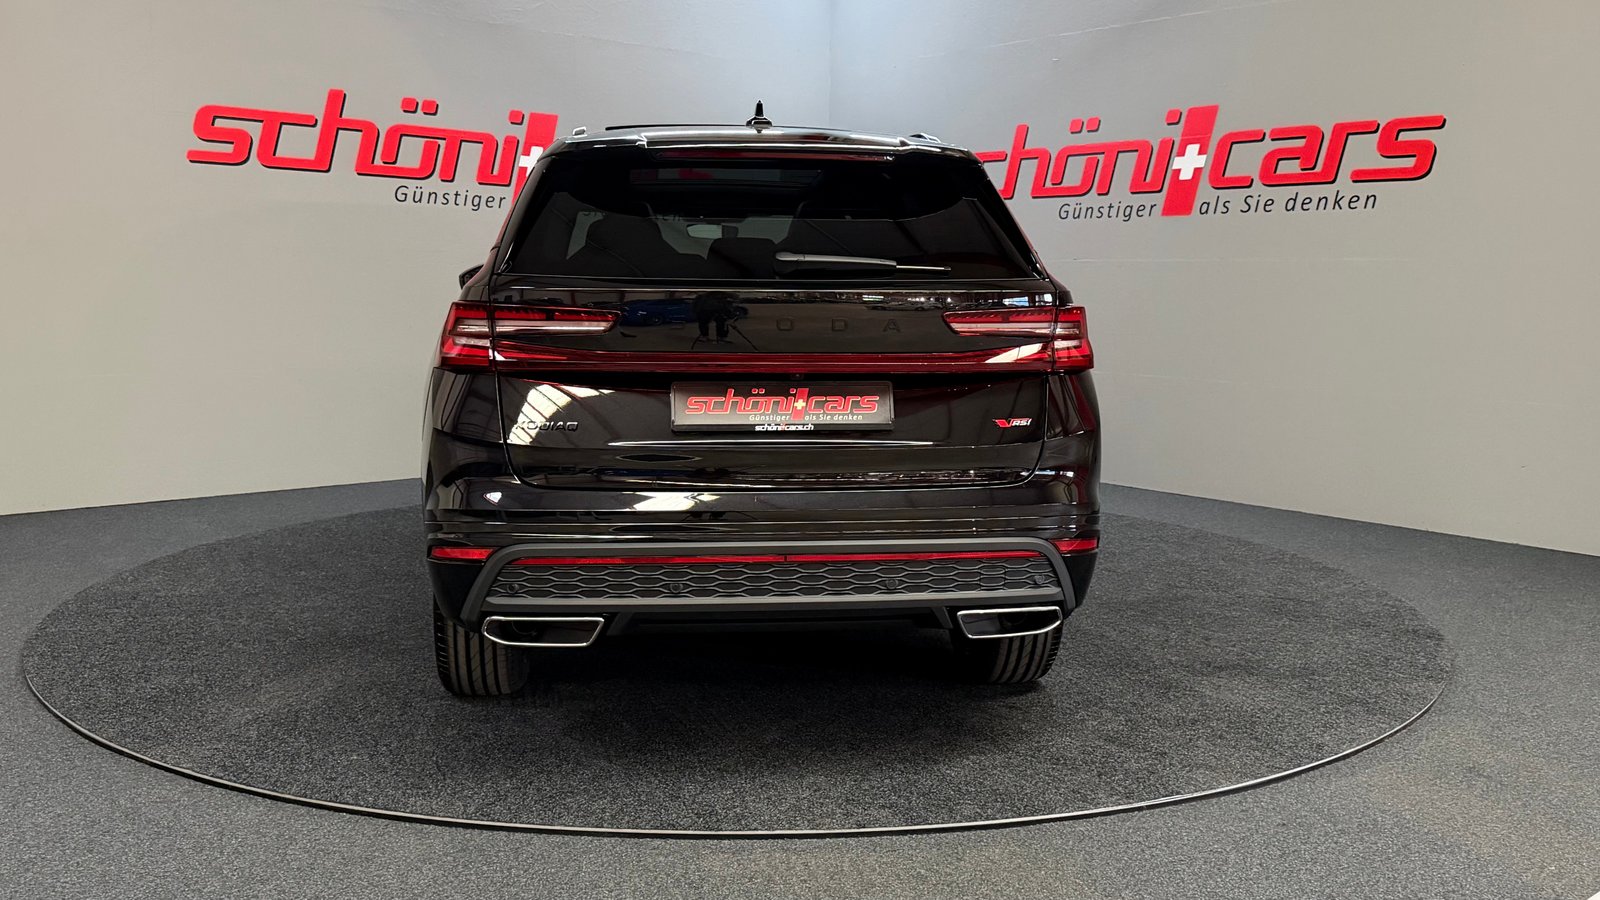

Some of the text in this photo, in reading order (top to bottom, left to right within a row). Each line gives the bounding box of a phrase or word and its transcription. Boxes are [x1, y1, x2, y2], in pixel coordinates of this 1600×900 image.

[1208, 114, 1447, 190] cars
[394, 185, 507, 212] Günstiger
[1058, 190, 1377, 223] Günstiger als Sie denken
[808, 395, 879, 413] cars
